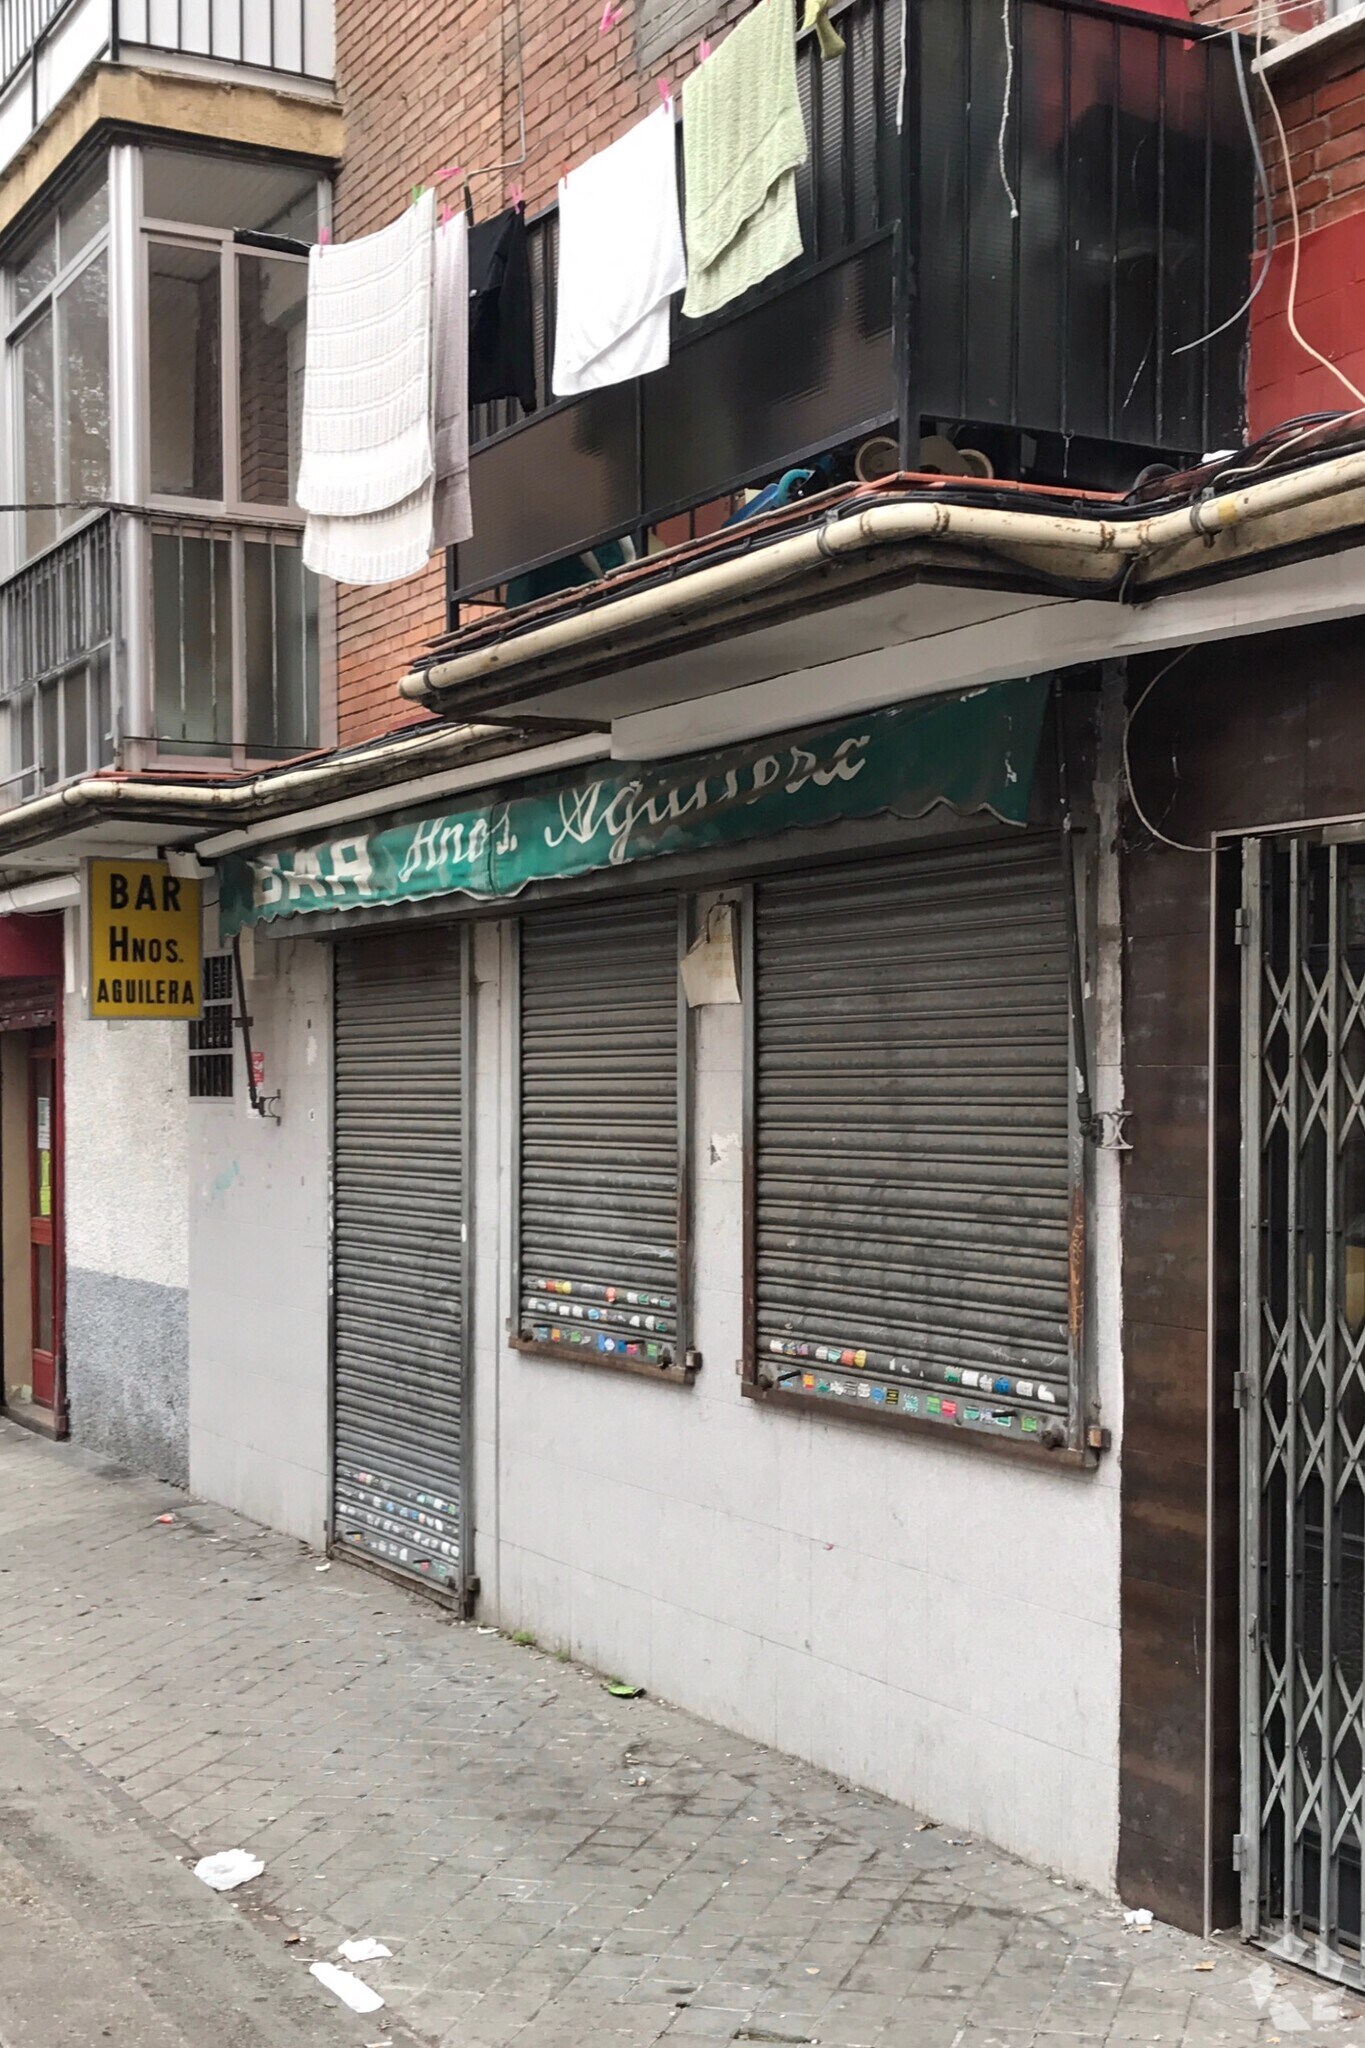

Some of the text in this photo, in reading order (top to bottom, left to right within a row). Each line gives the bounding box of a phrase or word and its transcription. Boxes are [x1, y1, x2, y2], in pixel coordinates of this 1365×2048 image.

[249, 835, 373, 906] BAR
[109, 873, 182, 912] BAR
[97, 979, 194, 1005] AGUILERA
